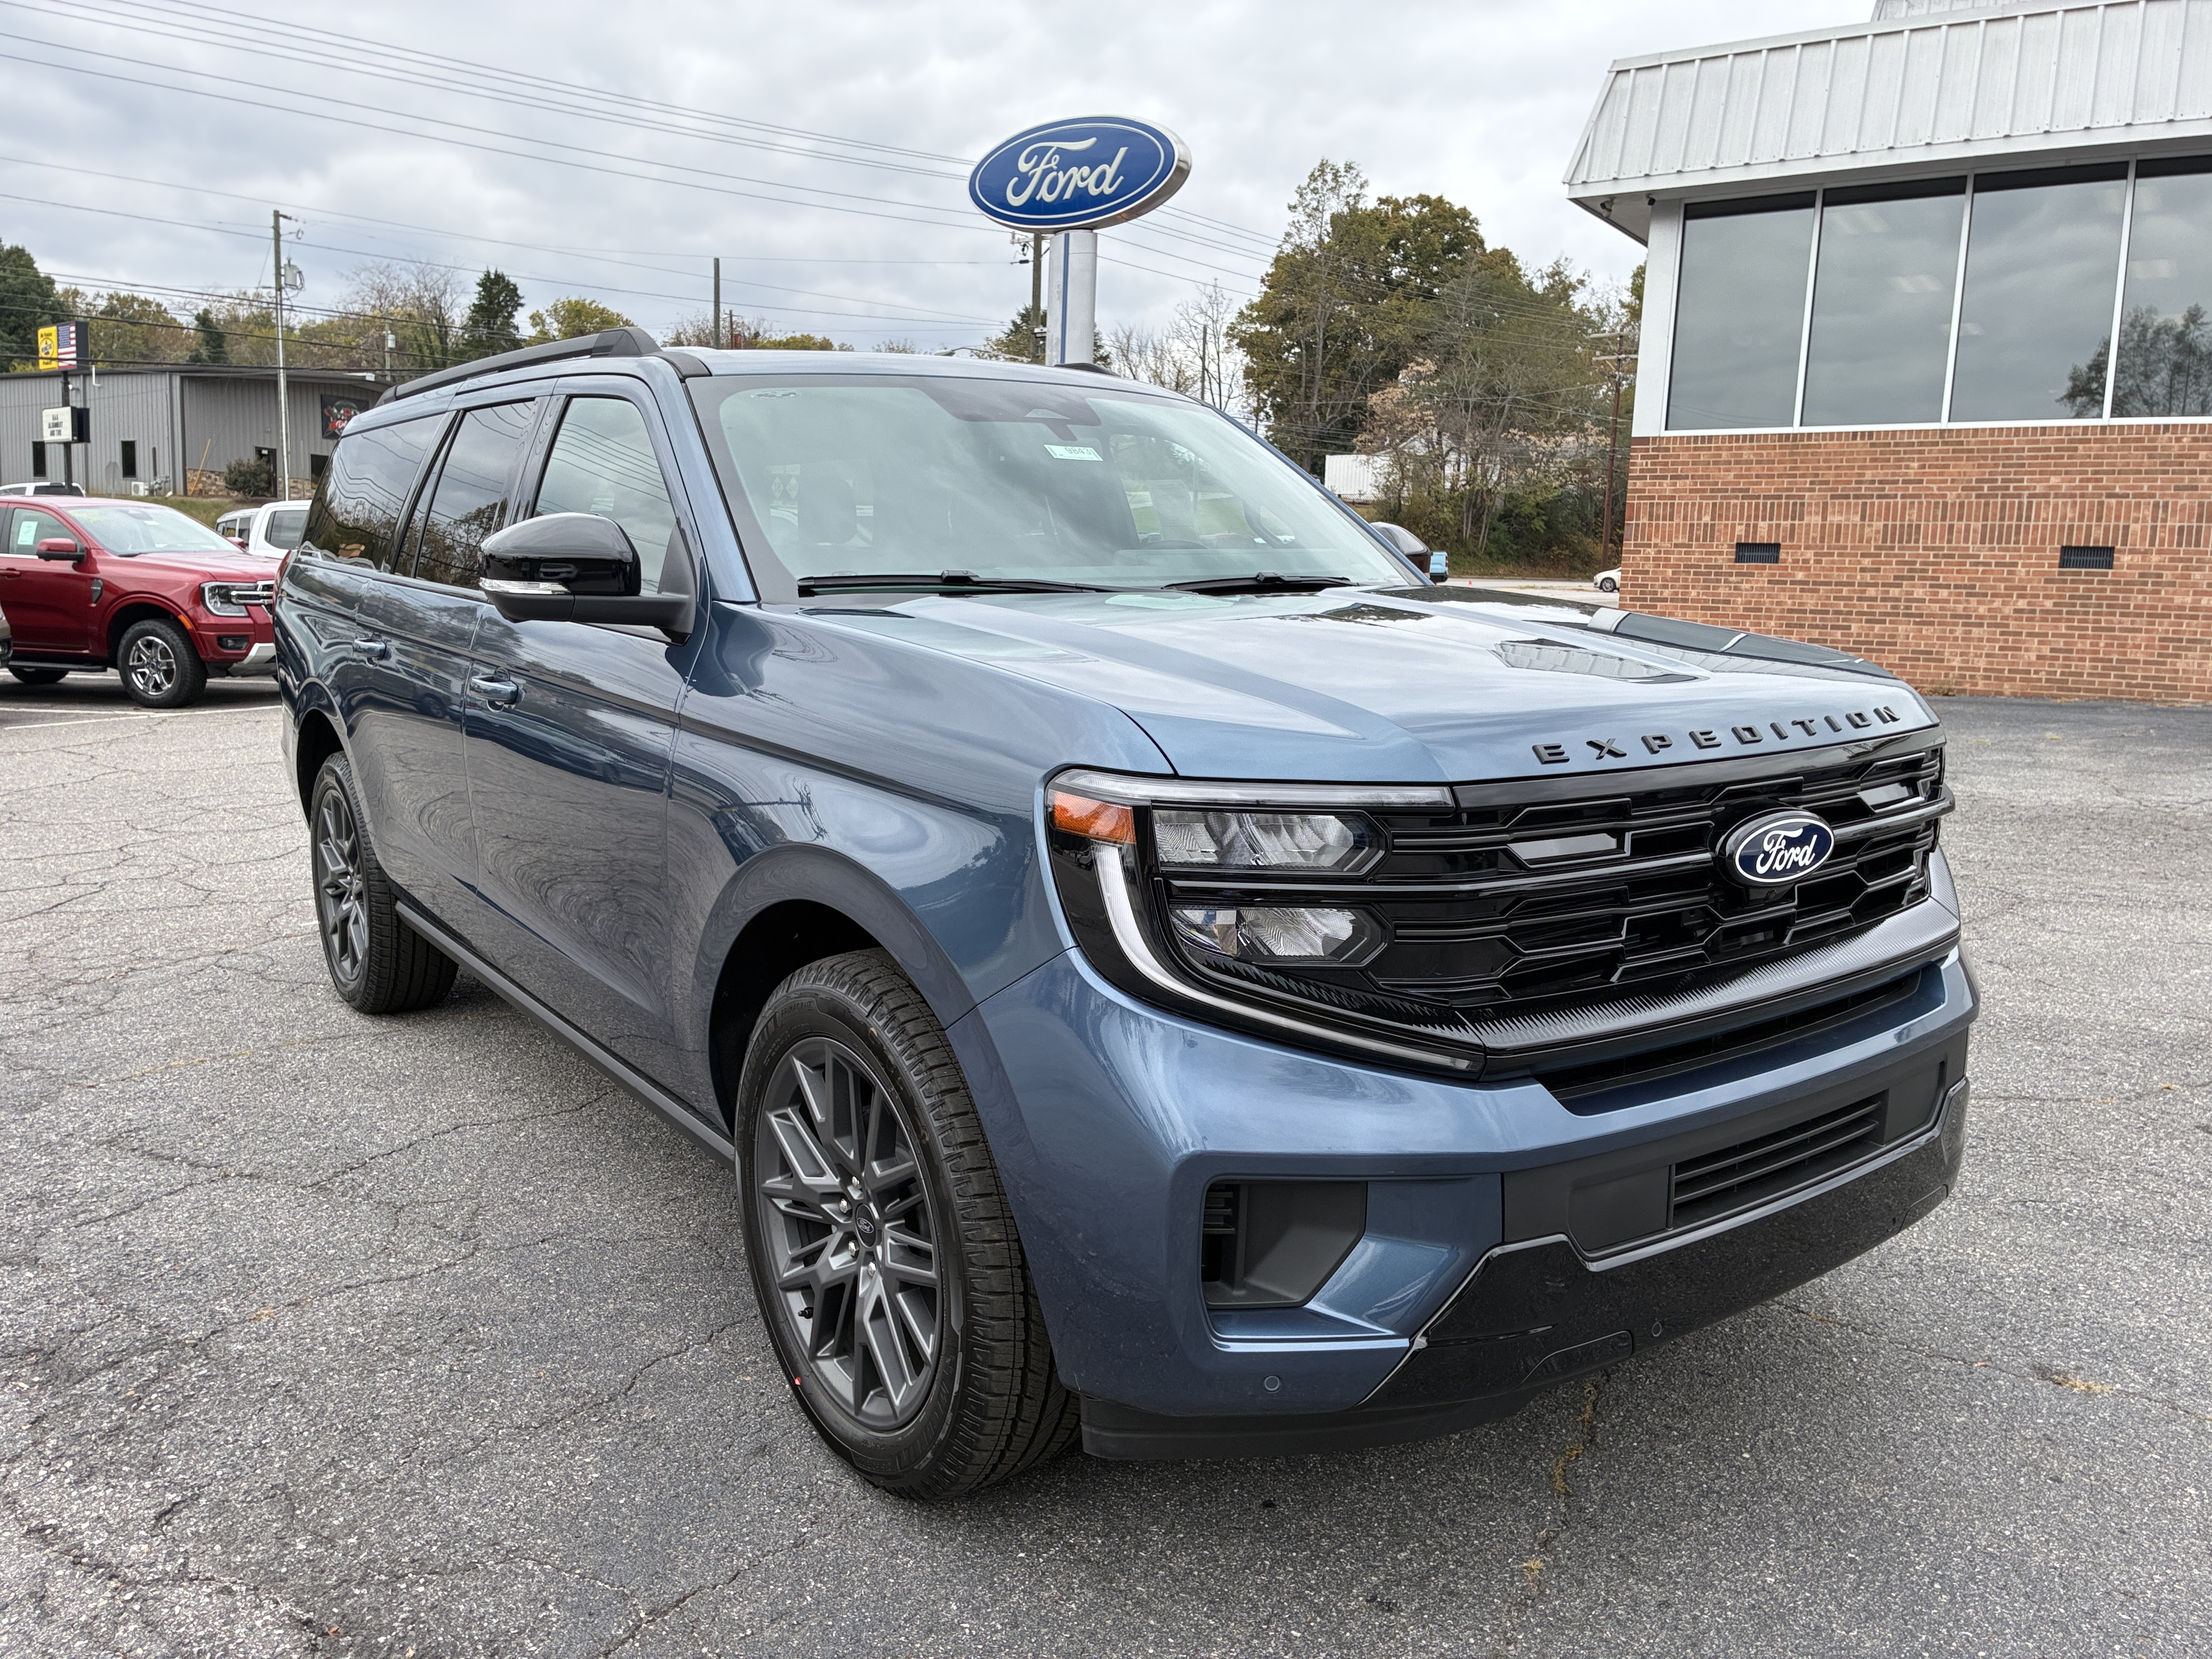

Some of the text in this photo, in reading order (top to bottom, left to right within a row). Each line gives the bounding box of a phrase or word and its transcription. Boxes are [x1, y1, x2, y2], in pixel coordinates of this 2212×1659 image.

[1006, 137, 1128, 207] Ford
[1064, 447, 1091, 455] 9843
[1532, 706, 1901, 764] EXPEDITION
[1756, 827, 1818, 874] Ford
[859, 1218, 871, 1232] Ford
